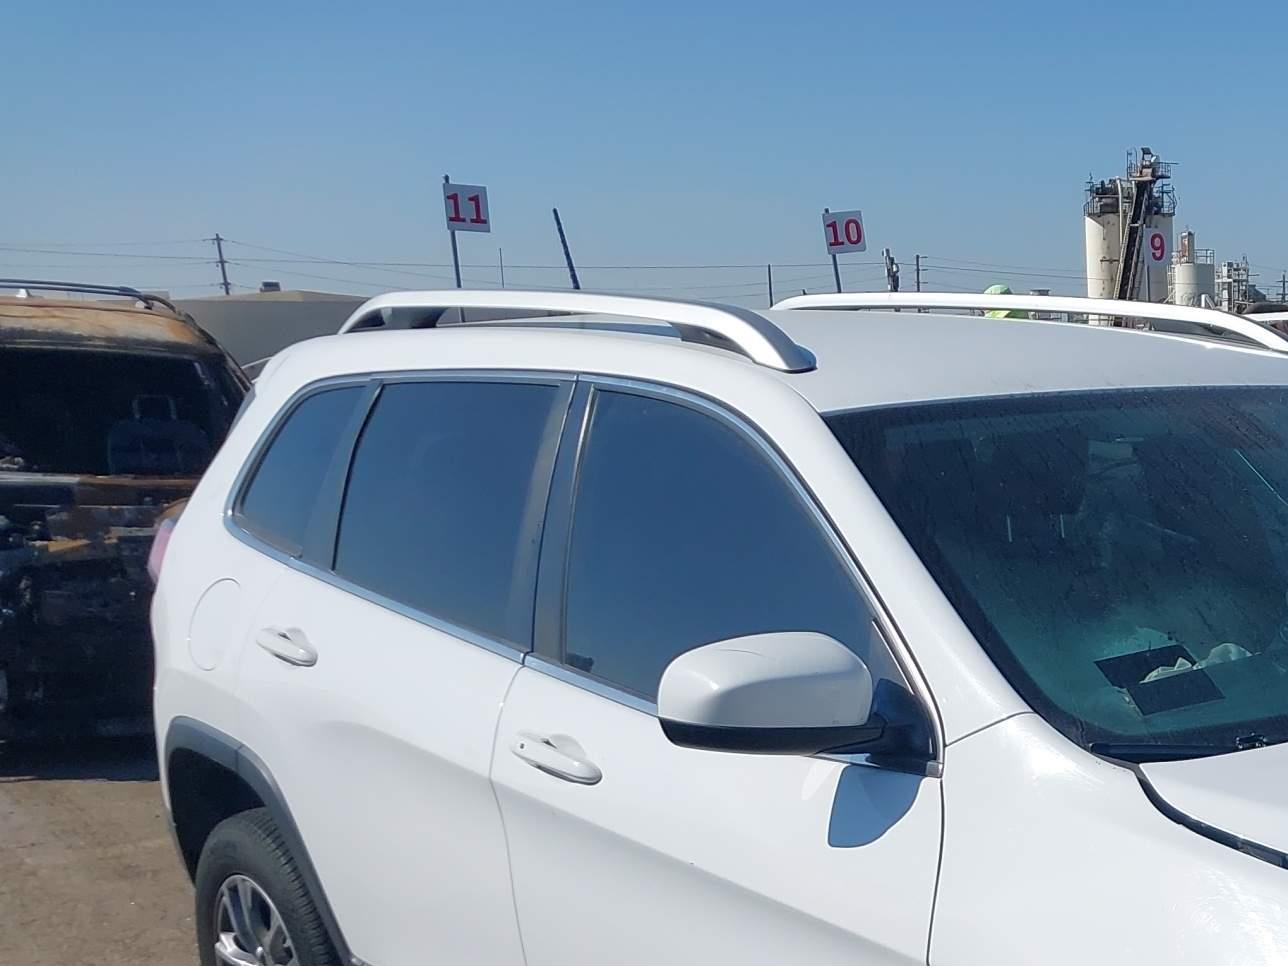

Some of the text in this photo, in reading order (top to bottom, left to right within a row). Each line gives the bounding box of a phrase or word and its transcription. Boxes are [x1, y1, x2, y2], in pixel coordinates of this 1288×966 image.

[447, 193, 487, 225] 11
[826, 219, 862, 246] 10
[1150, 232, 1165, 261] 9
